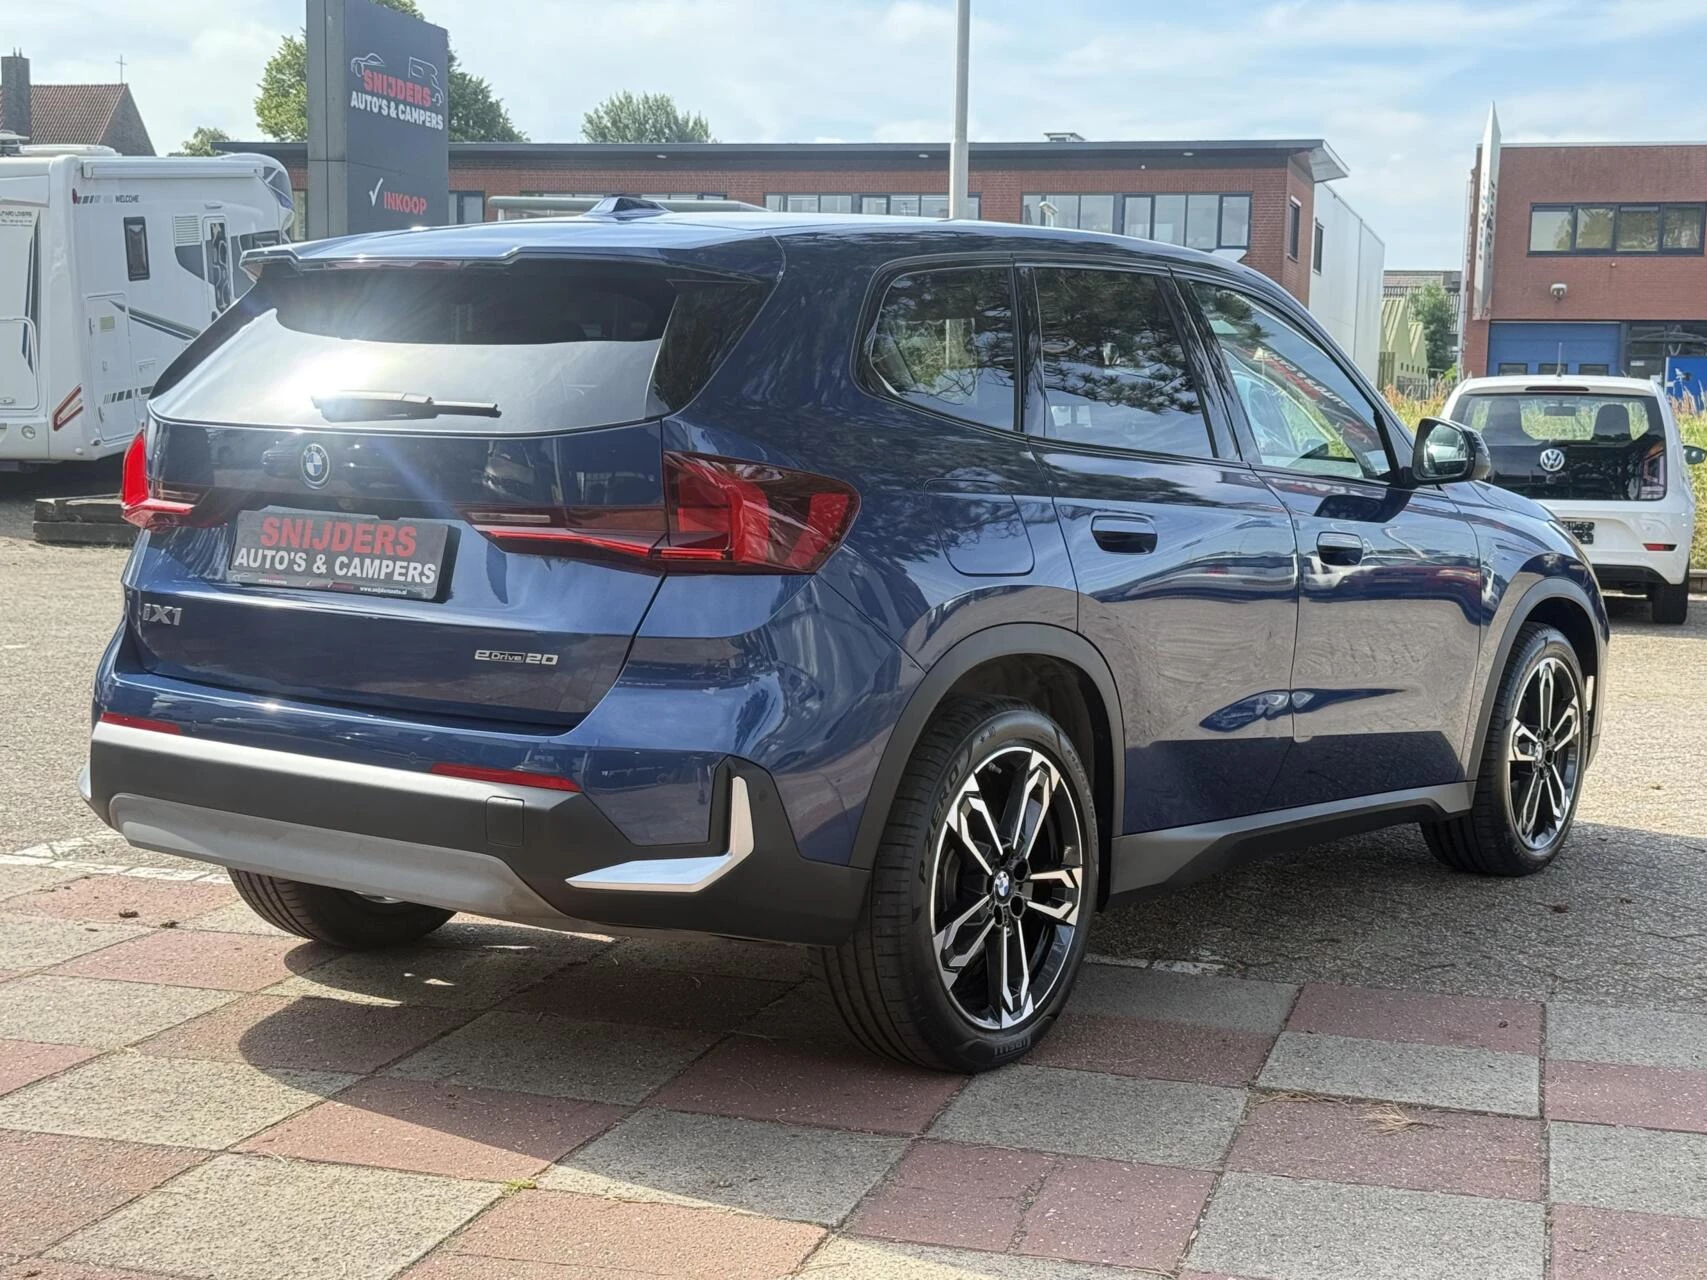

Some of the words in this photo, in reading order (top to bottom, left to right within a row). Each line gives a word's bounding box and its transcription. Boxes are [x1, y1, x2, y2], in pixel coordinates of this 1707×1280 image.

[363, 69, 432, 107] SNIJDERS
[350, 91, 388, 117] AUTO'S
[389, 102, 397, 118] &
[398, 103, 444, 130] CAMPERS
[115, 194, 140, 203] WELCOME
[383, 191, 428, 216] INKOOP
[259, 516, 418, 558] SNIJDERS
[234, 547, 307, 573] AUTO'S
[312, 553, 328, 575] &
[334, 556, 437, 584] CAMPERS
[525, 653, 559, 665] 20
[918, 859, 927, 885] P
[925, 763, 960, 854] ZERO
